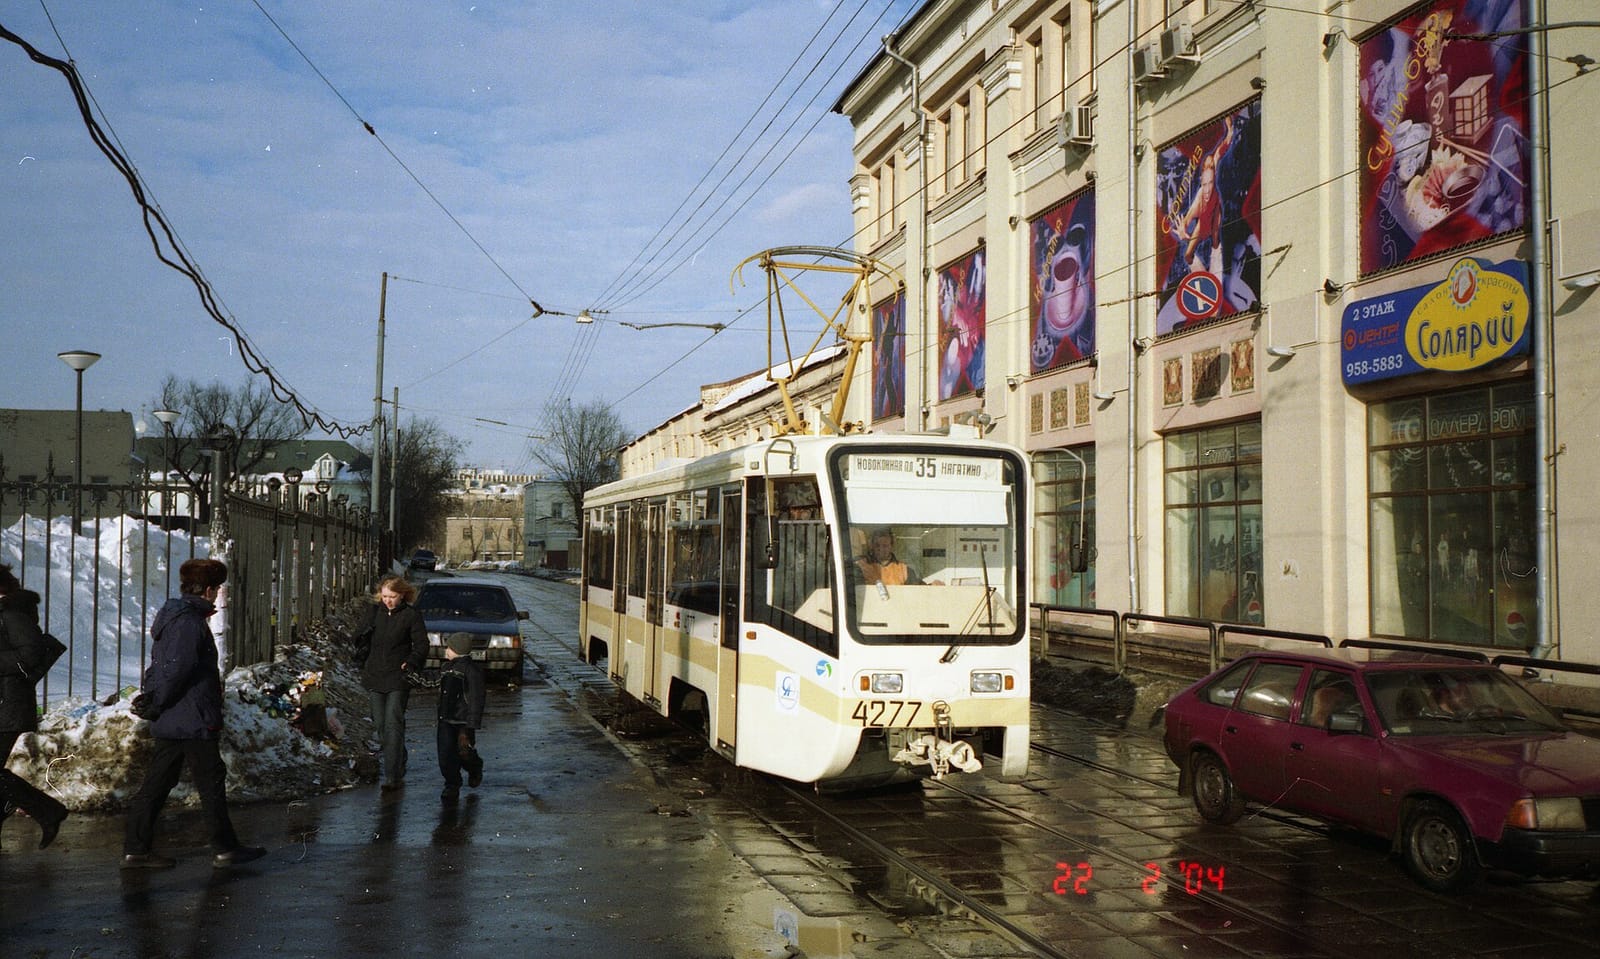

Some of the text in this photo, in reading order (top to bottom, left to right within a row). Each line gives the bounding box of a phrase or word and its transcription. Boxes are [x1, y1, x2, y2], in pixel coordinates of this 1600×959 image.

[1481, 276, 1520, 296] красоты
[1352, 301, 1395, 321] 2 ЭТАЖ
[1417, 301, 1515, 361] Солярий
[1346, 354, 1404, 377] 958-5883
[856, 457, 903, 472] НОВОКОННАЯ
[916, 457, 937, 478] 35
[941, 461, 982, 477] НАГАТИНО
[852, 700, 922, 727] 4277
